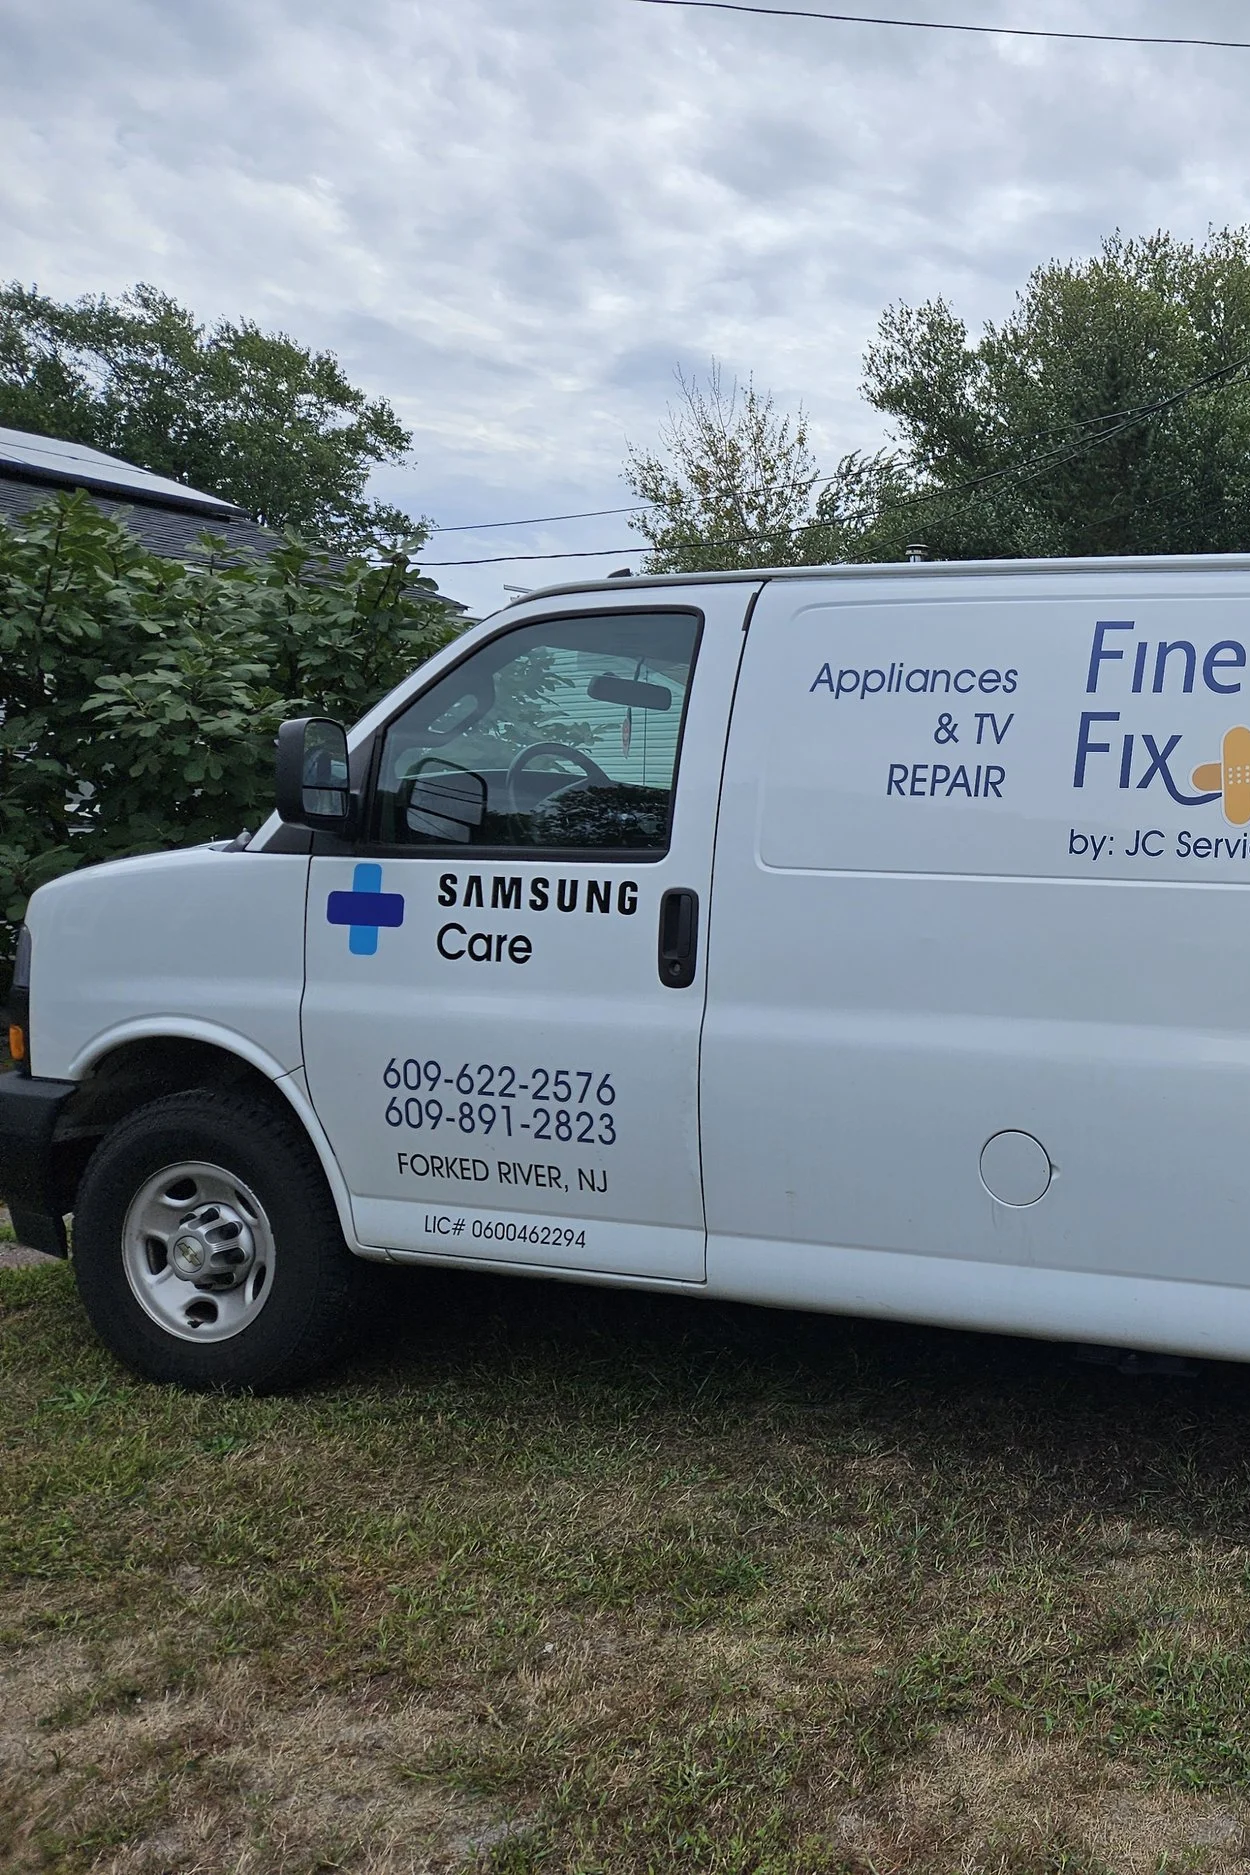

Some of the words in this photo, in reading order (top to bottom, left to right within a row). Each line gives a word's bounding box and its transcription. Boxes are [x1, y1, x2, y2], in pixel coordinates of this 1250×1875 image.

[1085, 620, 1247, 695] Fine
[808, 662, 1019, 700] Appliances
[933, 712, 960, 745] &
[974, 712, 1015, 745] TV
[1072, 711, 1184, 793] Fix
[886, 763, 1006, 798] REPAIR
[1068, 828, 1114, 861] by:
[1124, 829, 1166, 857] JC
[437, 873, 639, 916] SAMSUNG
[436, 922, 533, 965] Care
[382, 1057, 617, 1107] 609-622-2576
[384, 1096, 618, 1147] 609-891-2823
[397, 1152, 490, 1182] FORKED
[497, 1160, 569, 1193] RIVER,
[577, 1167, 608, 1193] NJ
[424, 1214, 466, 1236] LIC#
[471, 1219, 586, 1249] 0600462294
